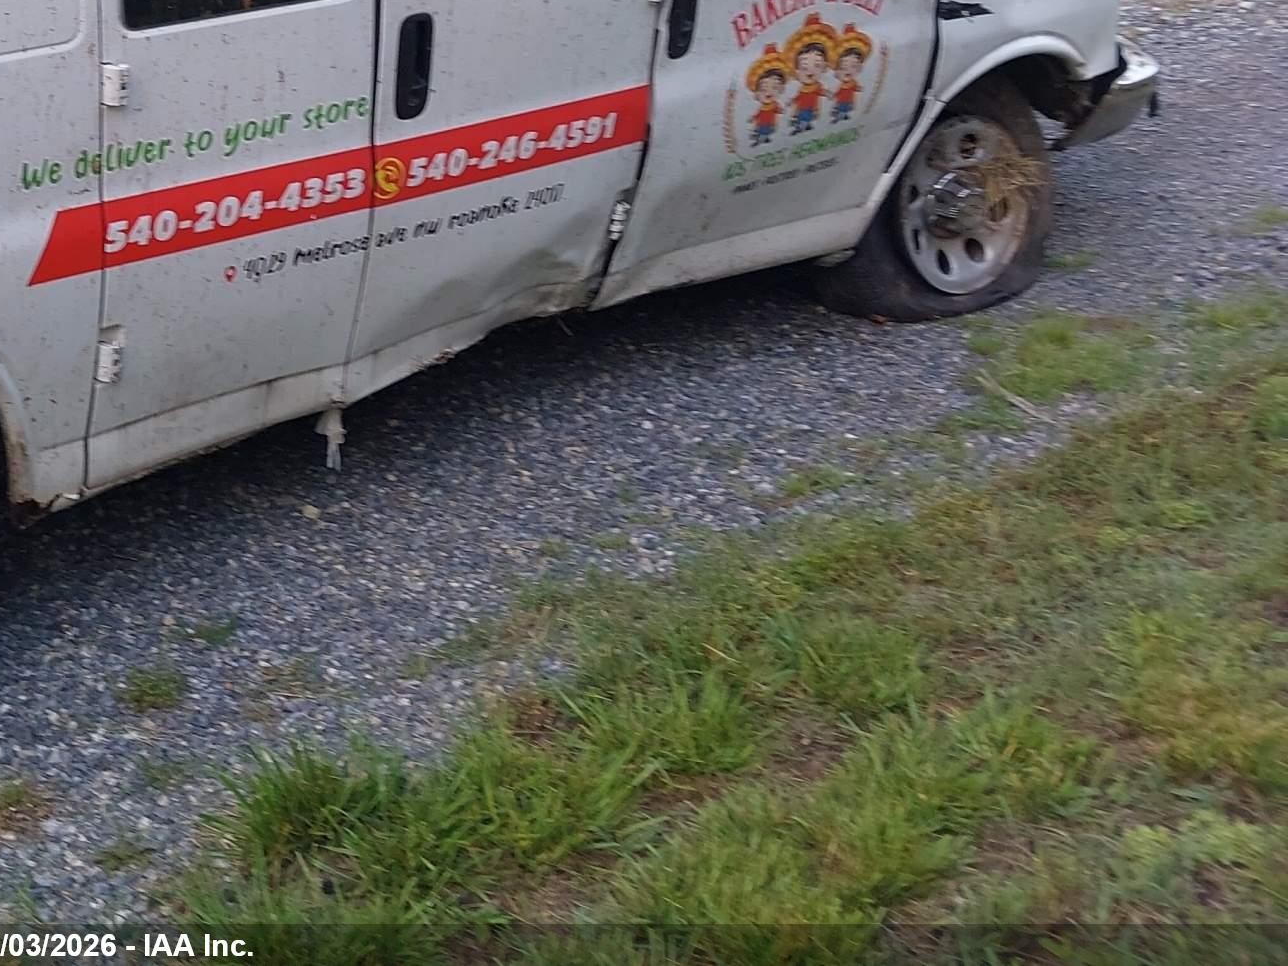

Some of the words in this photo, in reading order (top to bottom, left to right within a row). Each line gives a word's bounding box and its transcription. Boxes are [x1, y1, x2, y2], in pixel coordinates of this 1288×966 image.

[22, 161, 61, 190] We
[74, 138, 172, 178] deliver
[184, 130, 213, 158] to
[224, 112, 293, 157] your
[303, 96, 369, 130] store
[405, 112, 618, 188] 540-246-4591
[104, 168, 366, 254] 540-204-4353
